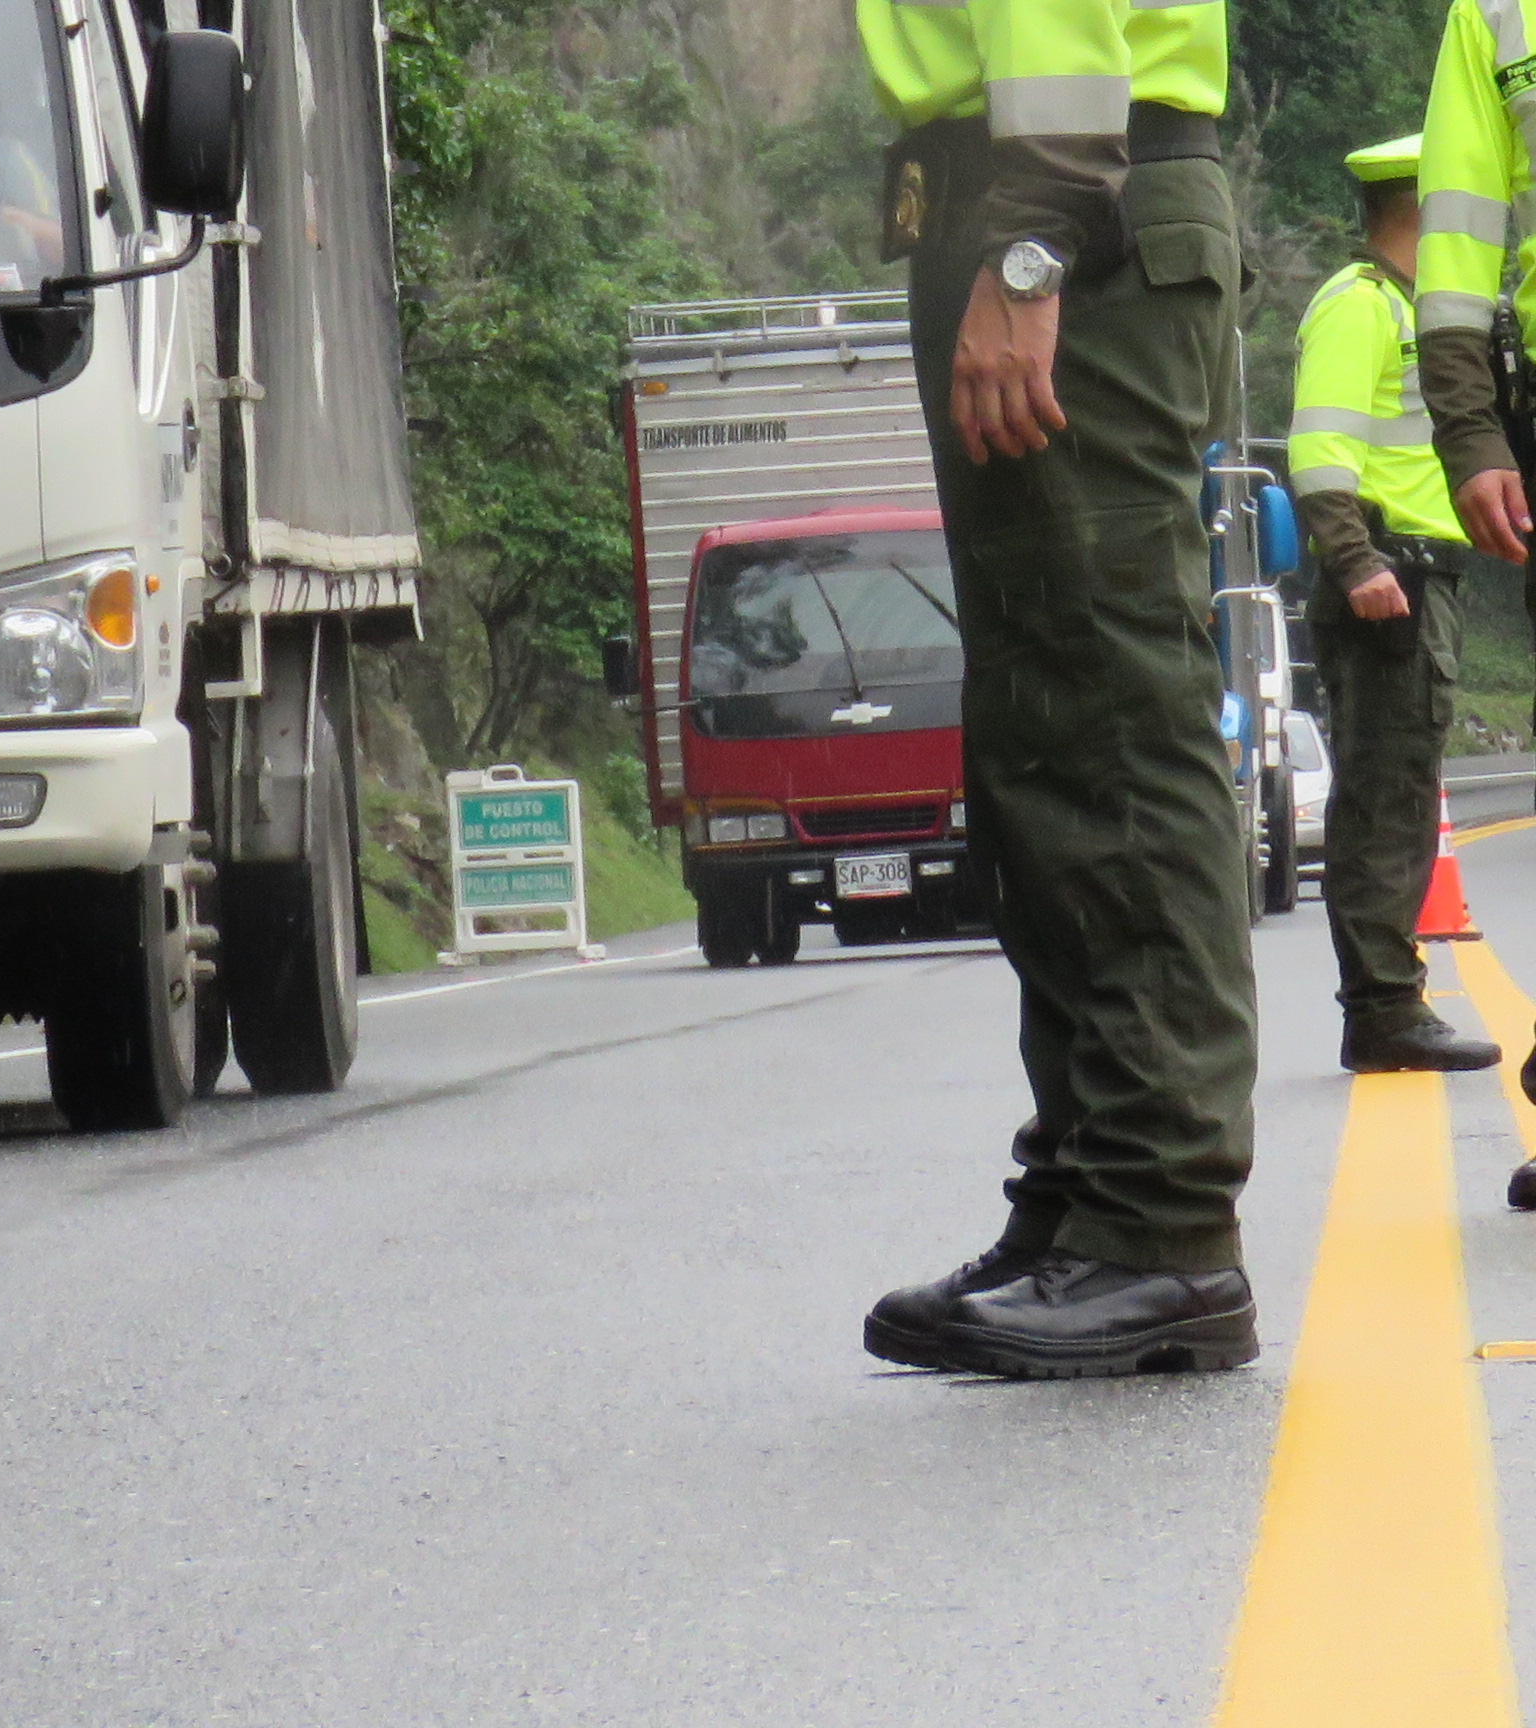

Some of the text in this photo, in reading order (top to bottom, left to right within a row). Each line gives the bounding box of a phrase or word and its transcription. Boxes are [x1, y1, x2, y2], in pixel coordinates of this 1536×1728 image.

[644, 420, 786, 449] TRANSPORTE DE ALIMENTOS
[481, 801, 543, 818] PUESTO
[464, 821, 562, 840] DE CONTROL
